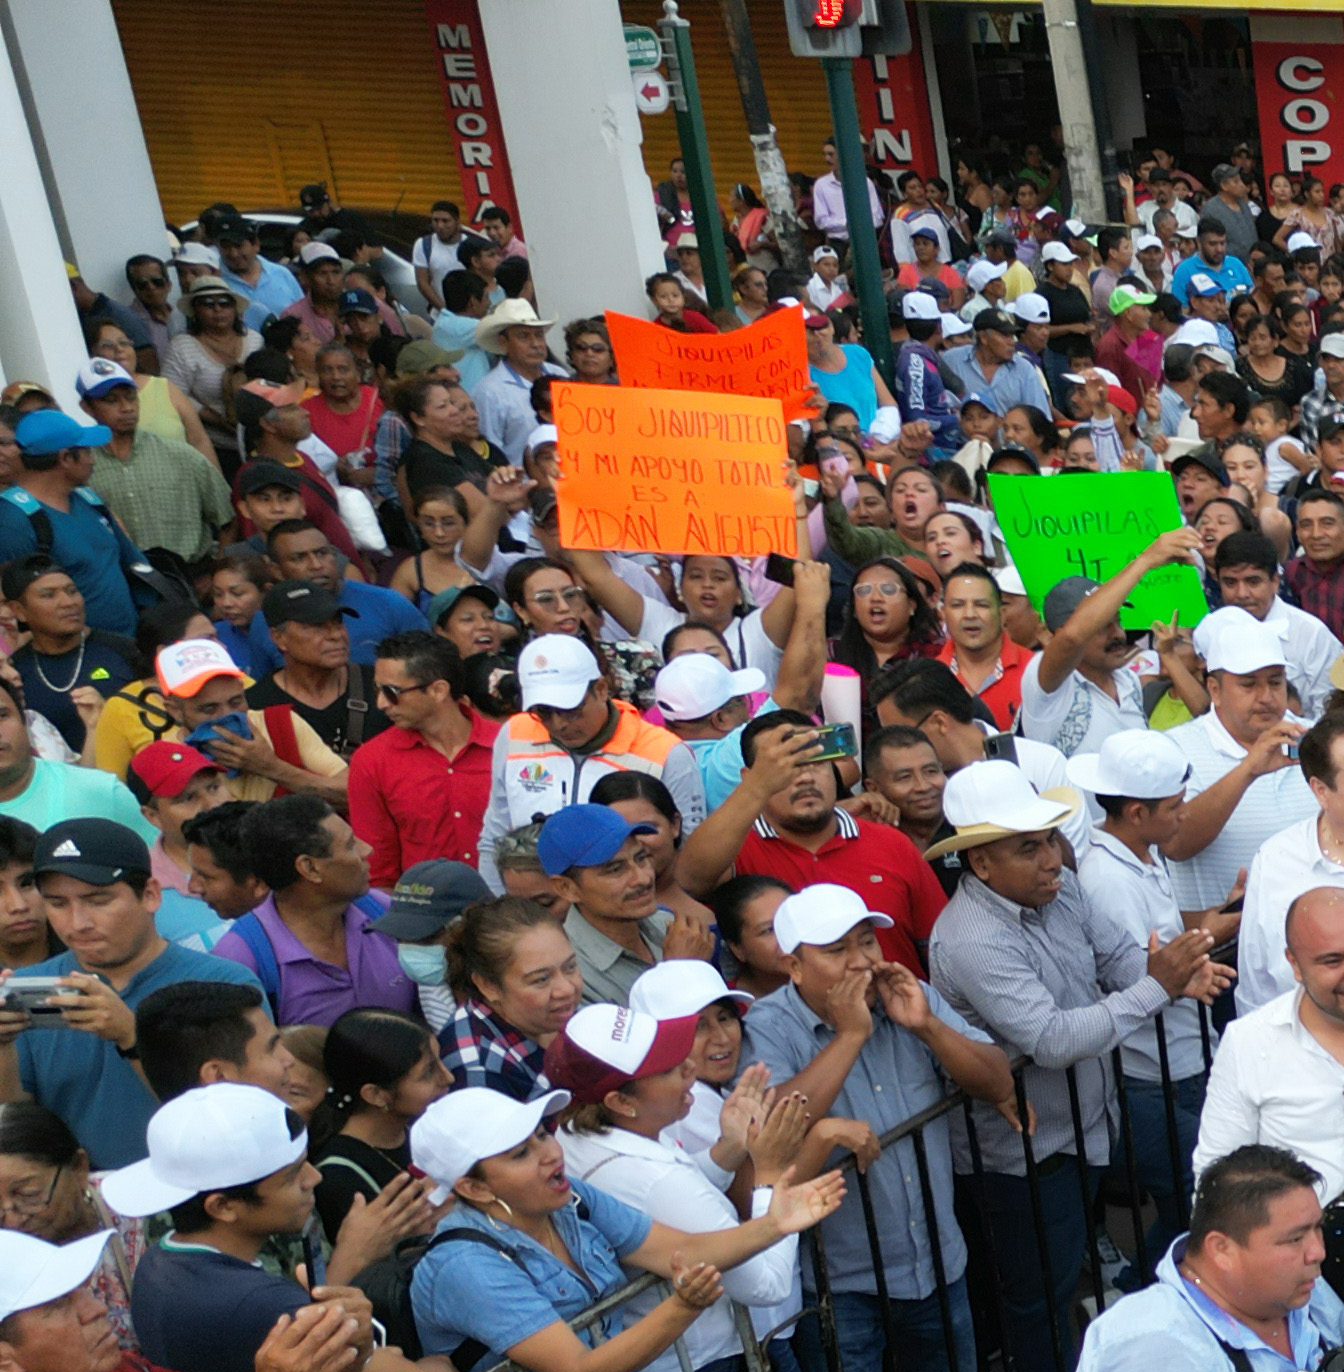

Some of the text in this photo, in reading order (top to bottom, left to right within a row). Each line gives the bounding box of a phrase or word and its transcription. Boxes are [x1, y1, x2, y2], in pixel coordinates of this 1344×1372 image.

[1275, 55, 1332, 175] COP
[755, 352, 792, 384] CON
[566, 450, 779, 488] Y MI APOYO TOTAL
[632, 484, 669, 502] ES
[571, 504, 798, 558] ADÁN AUGUSTO
